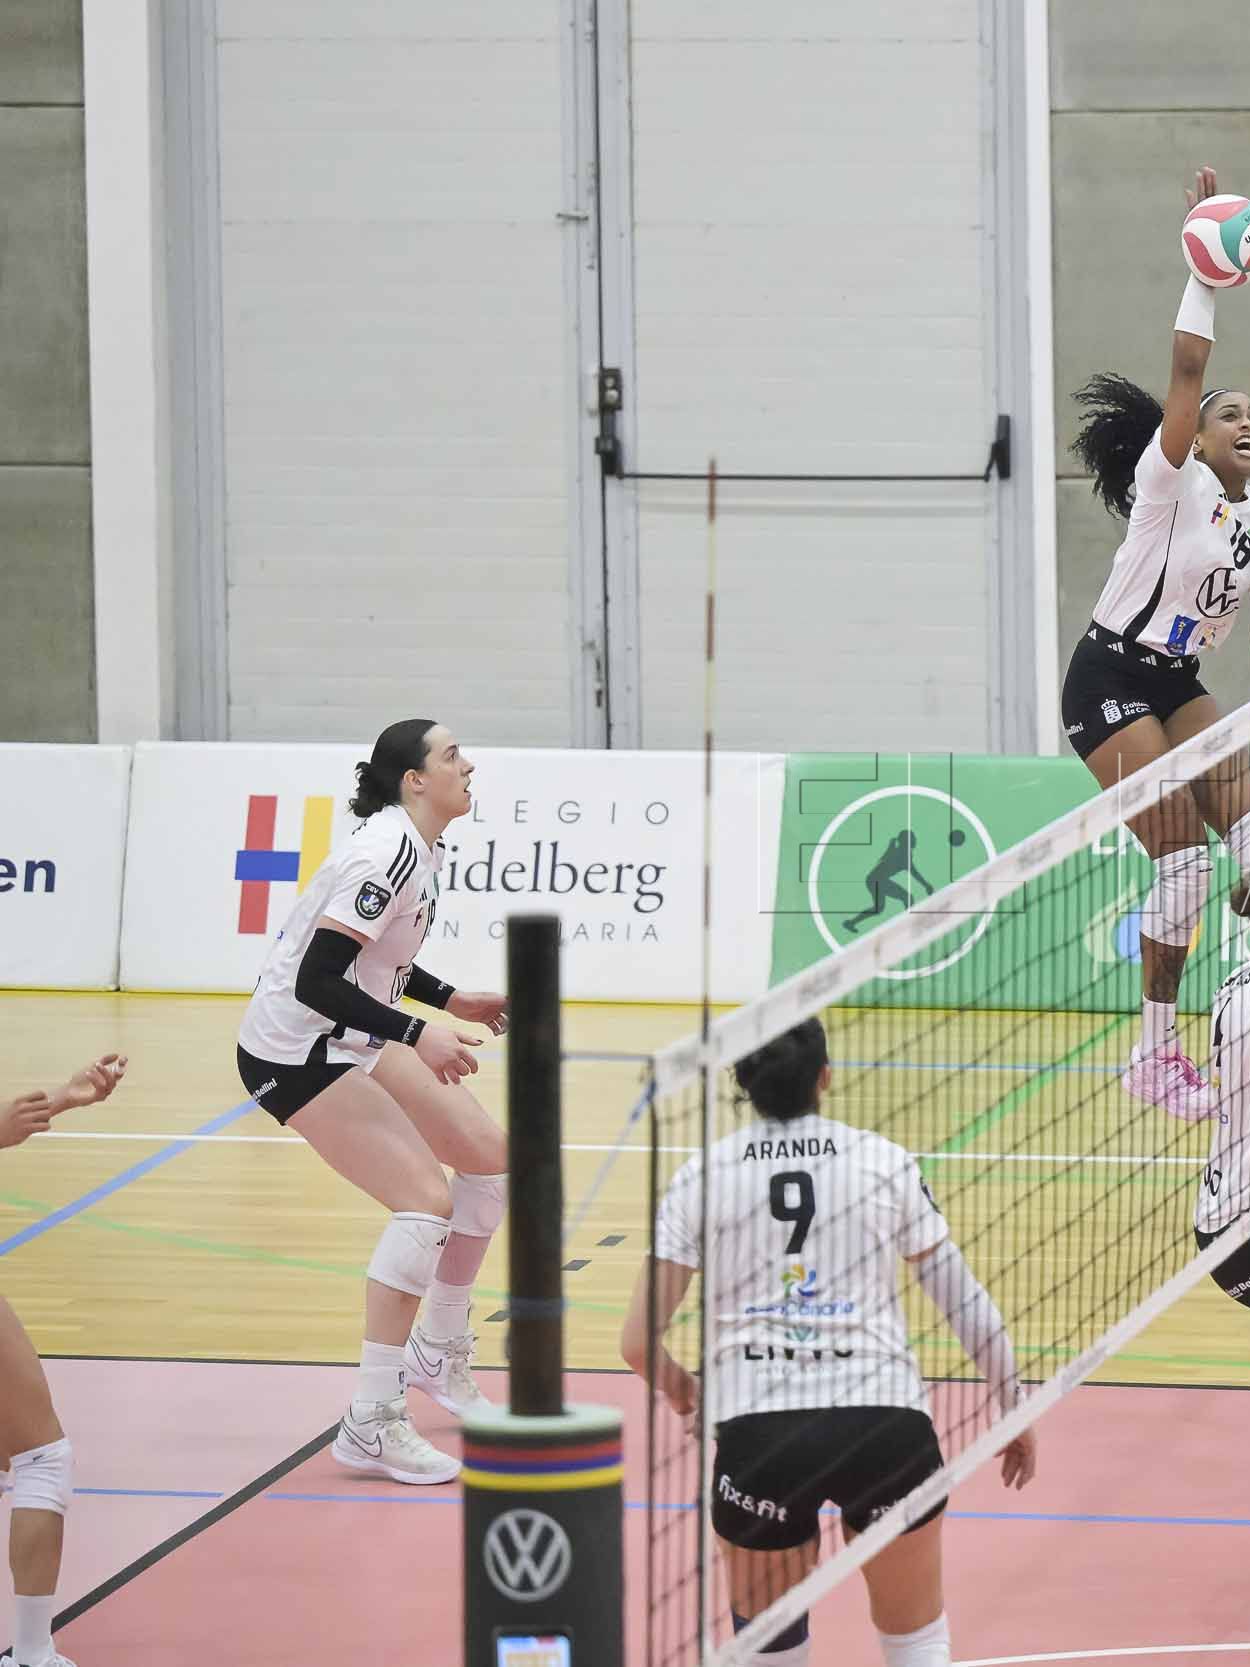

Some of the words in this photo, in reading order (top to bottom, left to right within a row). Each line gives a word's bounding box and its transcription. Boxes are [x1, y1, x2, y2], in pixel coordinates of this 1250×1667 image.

[473, 800, 669, 825] LEGIO
[446, 839, 667, 914] idelberg
[743, 1138, 837, 1160] ARANDA
[769, 1170, 816, 1255] 9
